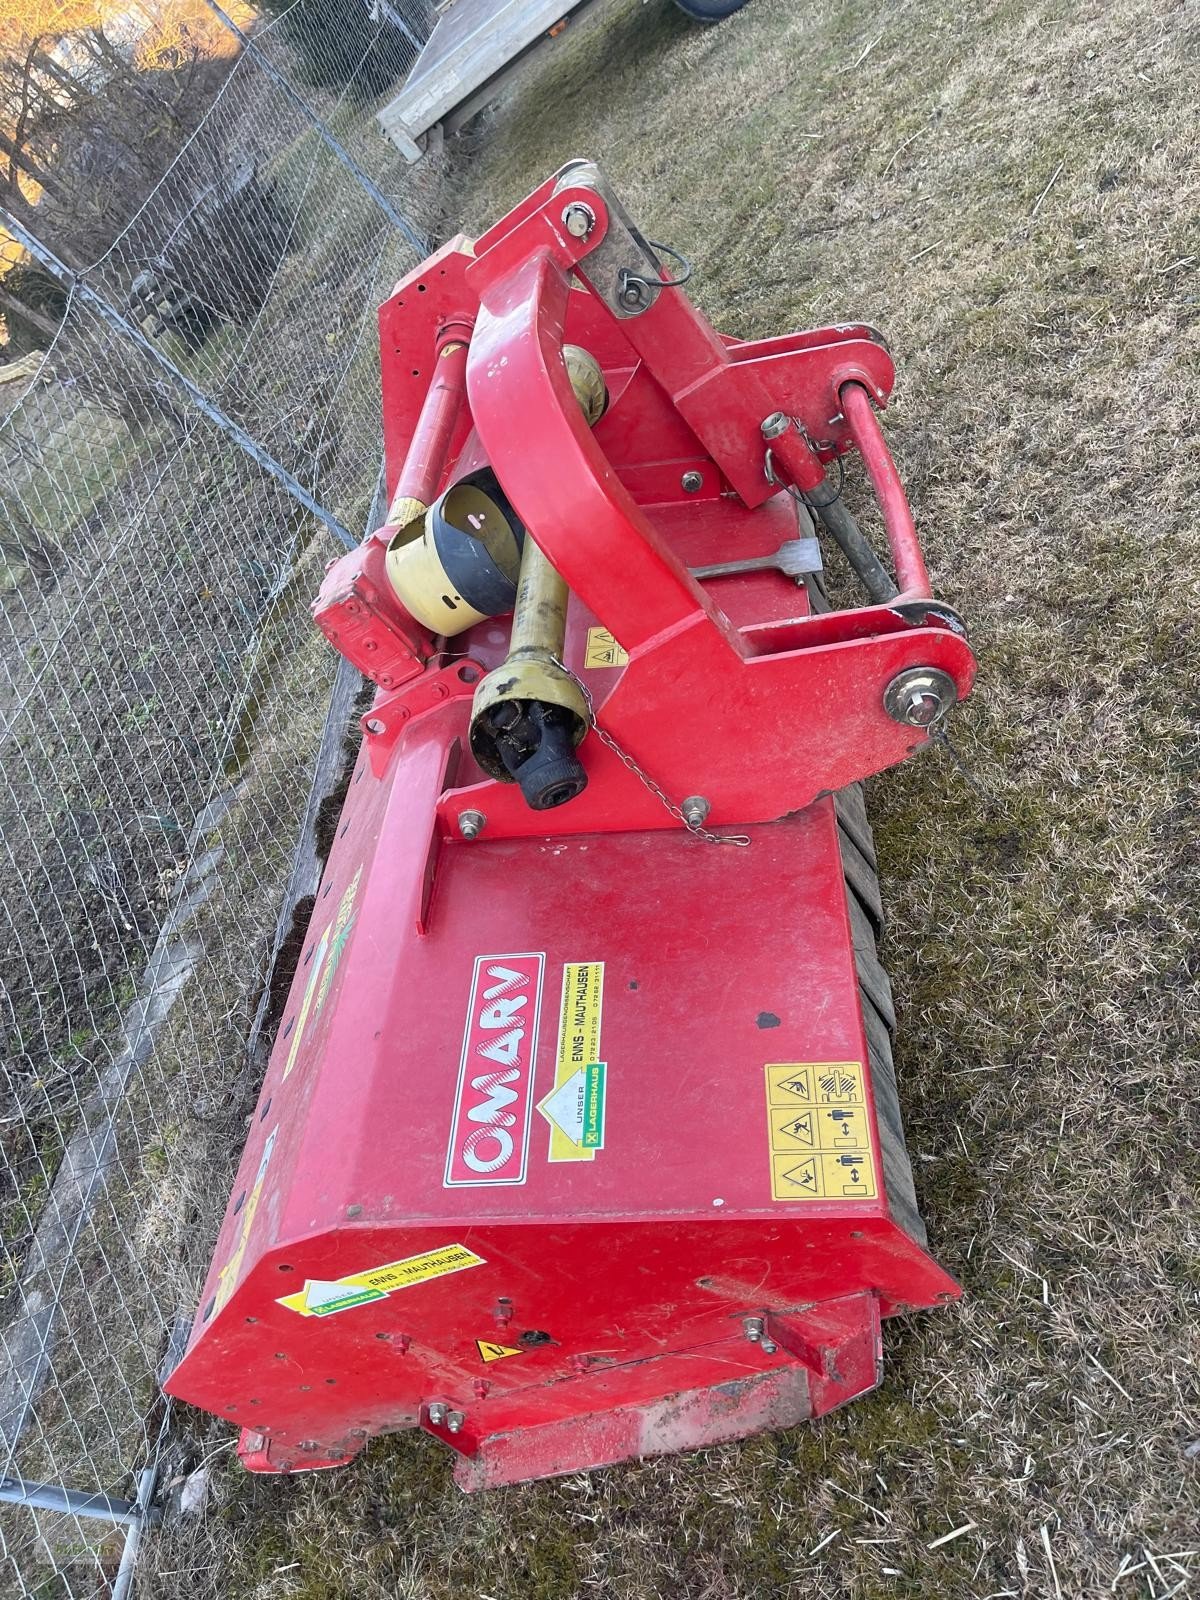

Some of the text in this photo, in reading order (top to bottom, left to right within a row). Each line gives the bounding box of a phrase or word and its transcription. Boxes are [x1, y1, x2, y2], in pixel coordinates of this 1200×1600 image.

[574, 965, 589, 1026] MAUTHAUSEN
[462, 965, 530, 1173] OMARV
[572, 1036, 584, 1062] ENNS
[576, 1086, 585, 1124] UNSER
[589, 1067, 600, 1132] LAGERHAUS
[368, 1273, 398, 1286] ENNS
[402, 1250, 472, 1276] MAUTHAUSEN
